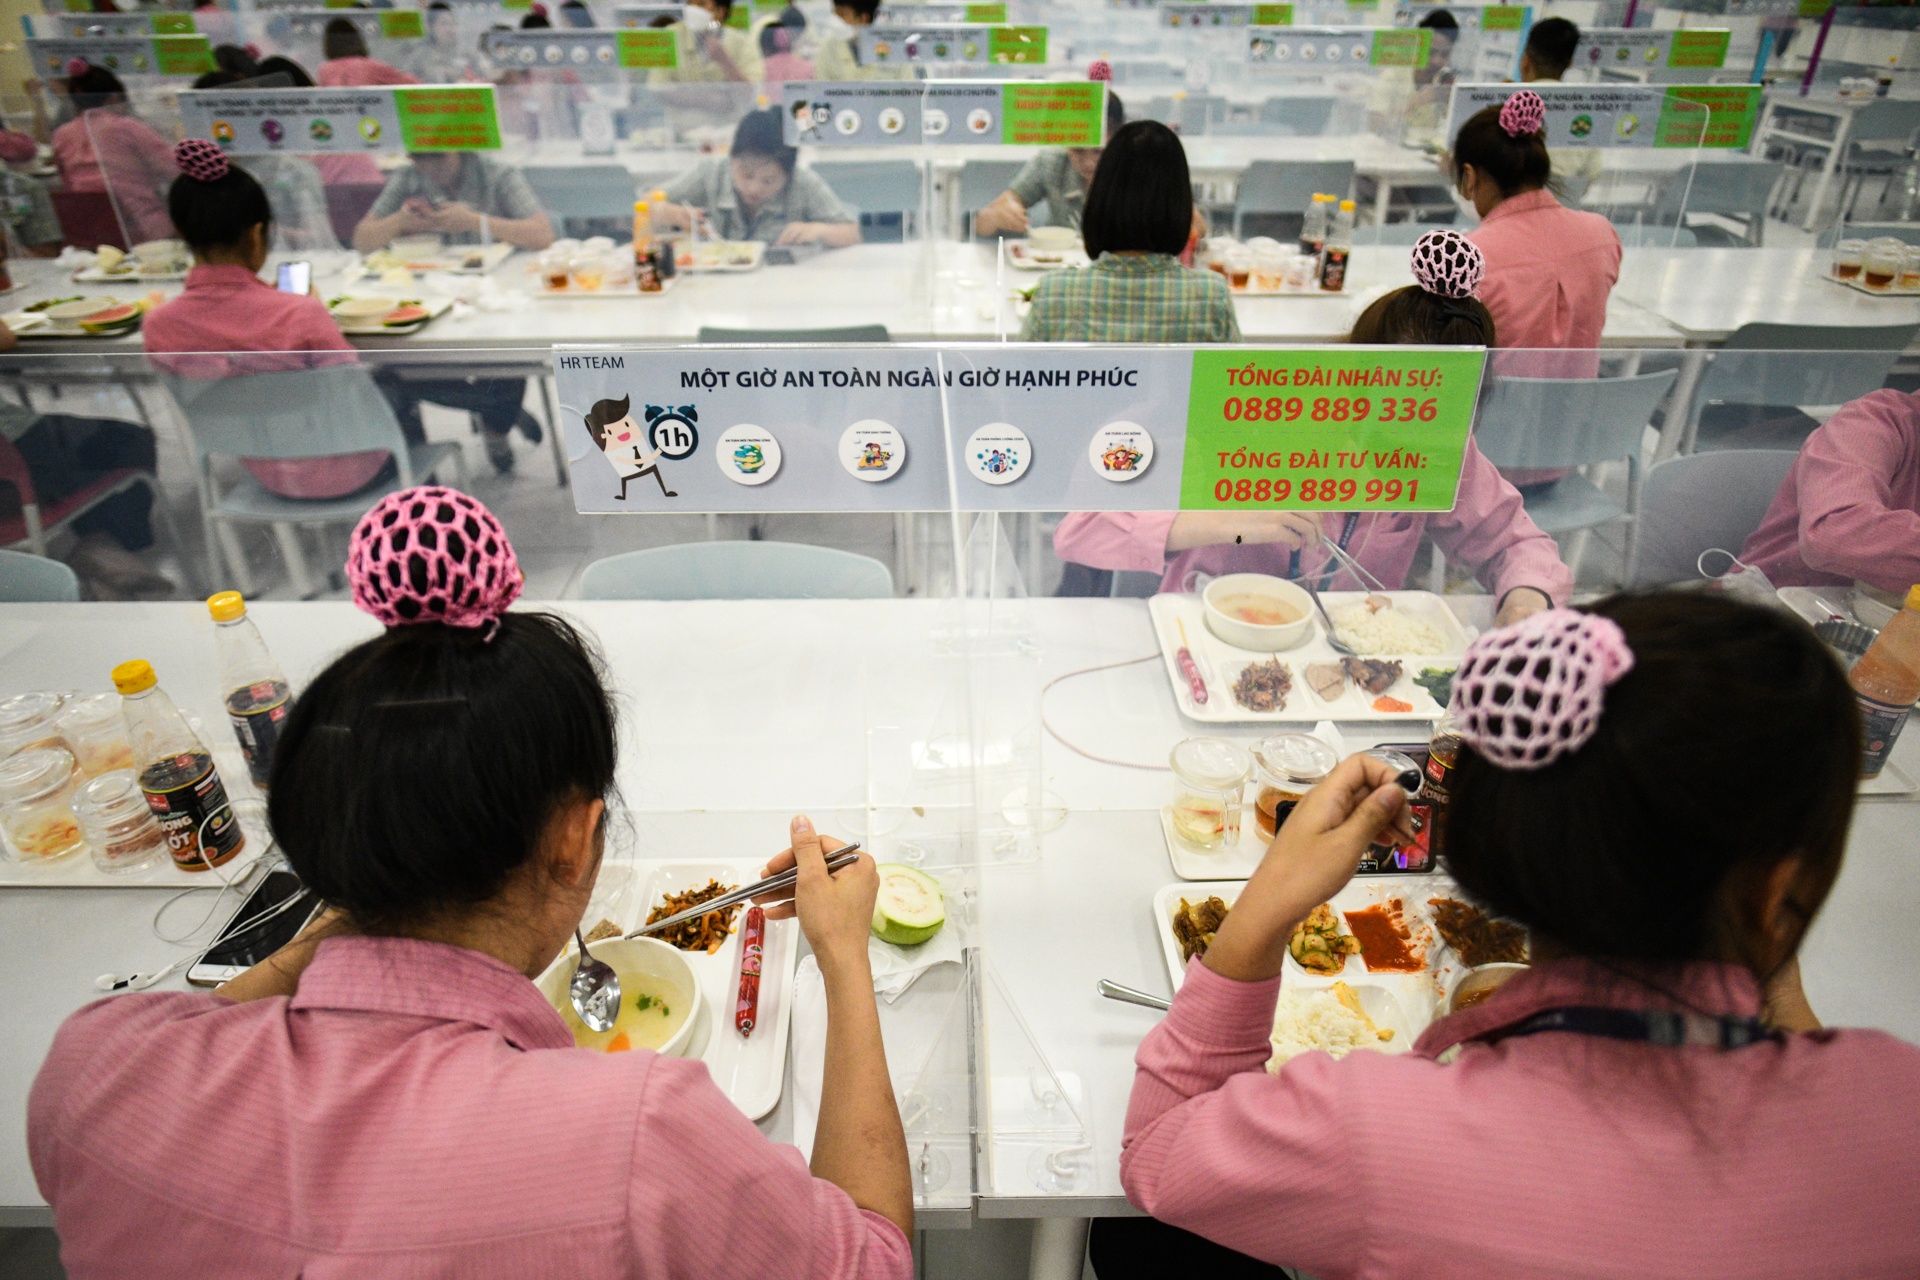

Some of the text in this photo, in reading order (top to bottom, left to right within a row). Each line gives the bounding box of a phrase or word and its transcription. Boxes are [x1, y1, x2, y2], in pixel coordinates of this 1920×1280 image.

[560, 356, 625, 369] HR TEAM
[680, 366, 1138, 392] MỘT GIỜ AN TOÀN NGÀN GIỜ HẠNH PHÚC
[1226, 362, 1443, 391] TỔNG ĐÀI NHÂN SỰ:
[1223, 397, 1438, 422] 0889 889 336
[659, 427, 689, 447] 1h
[1217, 446, 1428, 469] TỔNG ĐÀI TƯ VẤN:
[1214, 478, 1419, 502] 0889 889 991
